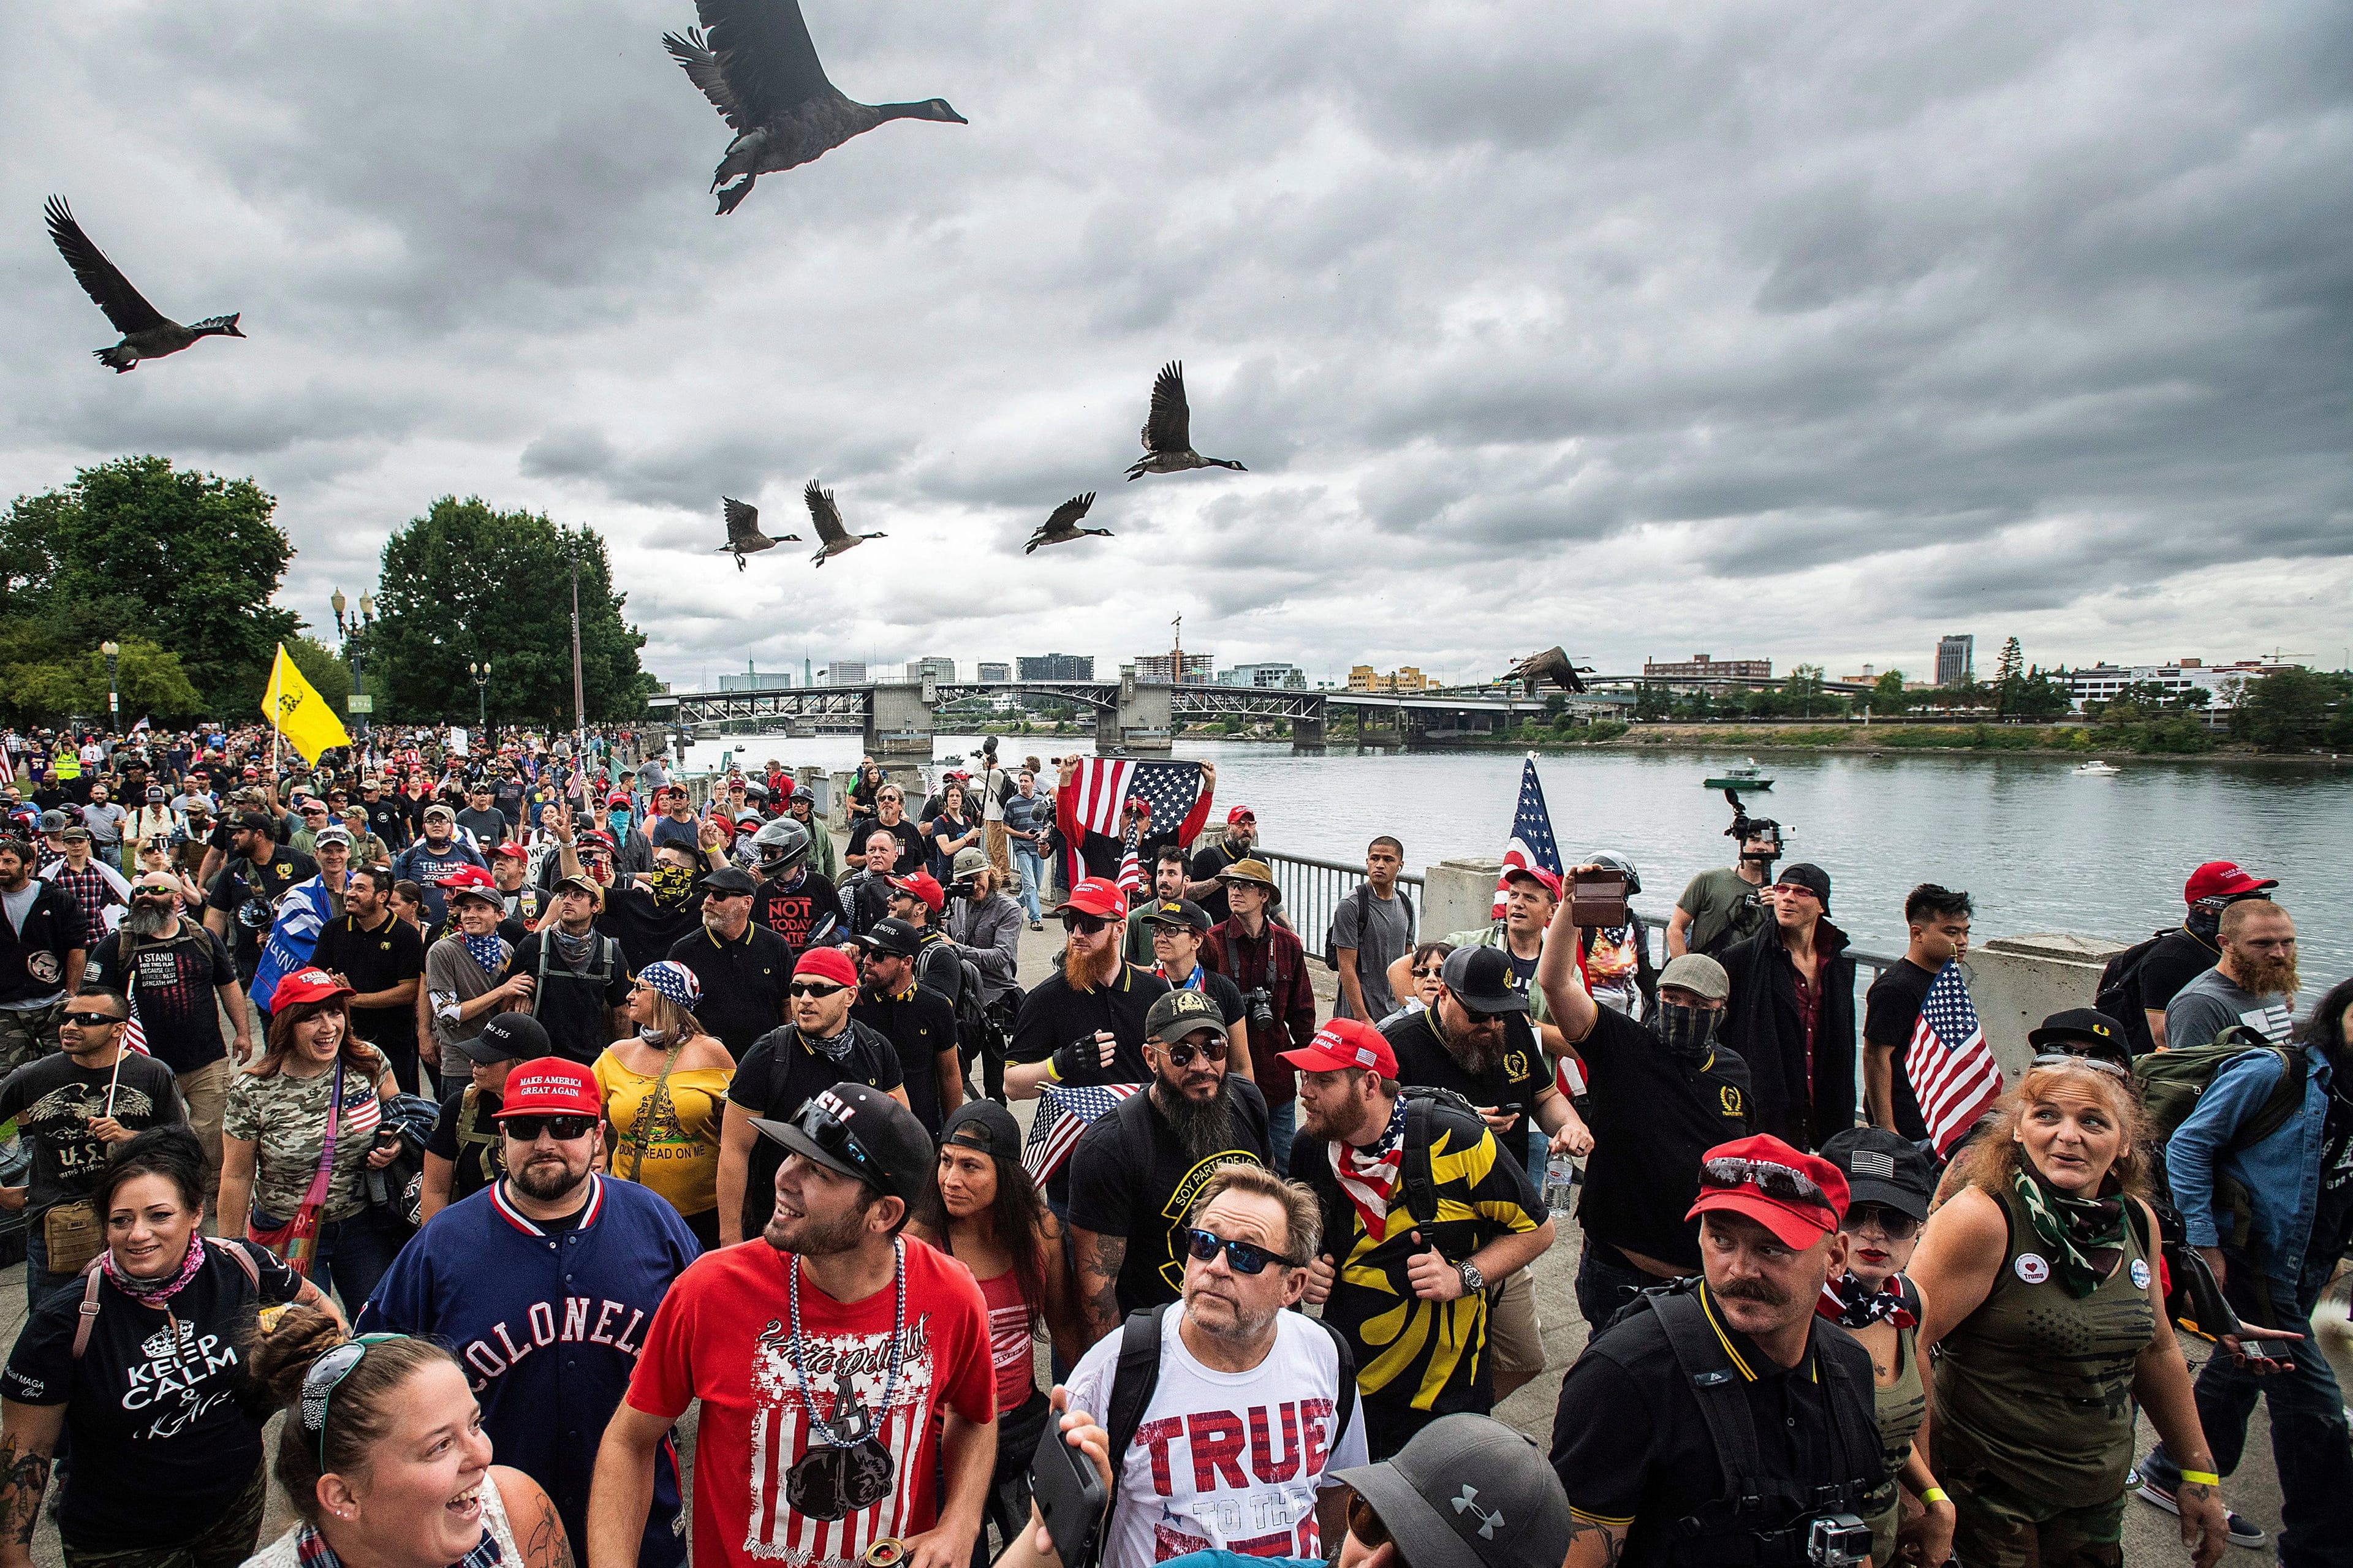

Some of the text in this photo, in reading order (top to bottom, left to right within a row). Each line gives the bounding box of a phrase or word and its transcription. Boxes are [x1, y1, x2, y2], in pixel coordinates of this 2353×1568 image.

[528, 846, 545, 858] WE
[769, 901, 812, 918] NOT
[770, 919, 813, 931] TODAY
[779, 931, 807, 944] NTIF
[144, 952, 174, 963] STAND
[495, 1028, 512, 1039] 355
[519, 1075, 582, 1087] MAKE AMERICA
[521, 1086, 579, 1097] GREAT AGAIN
[643, 1147, 673, 1159] READ
[676, 1146, 692, 1159] ON
[694, 1145, 705, 1157] ME
[1175, 1180, 1195, 1206] SOY
[466, 1297, 644, 1392] OLONEL
[839, 1311, 931, 1377] Delight
[127, 1334, 218, 1387] KEEP
[993, 1350, 1020, 1365] NEVER
[18, 1374, 45, 1390] MAGA
[123, 1346, 238, 1410] CALM
[21, 1387, 44, 1398] Girl
[179, 1388, 201, 1407] &
[1134, 1398, 1334, 1497] TRUE
[1192, 1487, 1308, 1536] TO THE
[743, 1537, 776, 1561] Fight
[776, 1544, 815, 1568] Night
